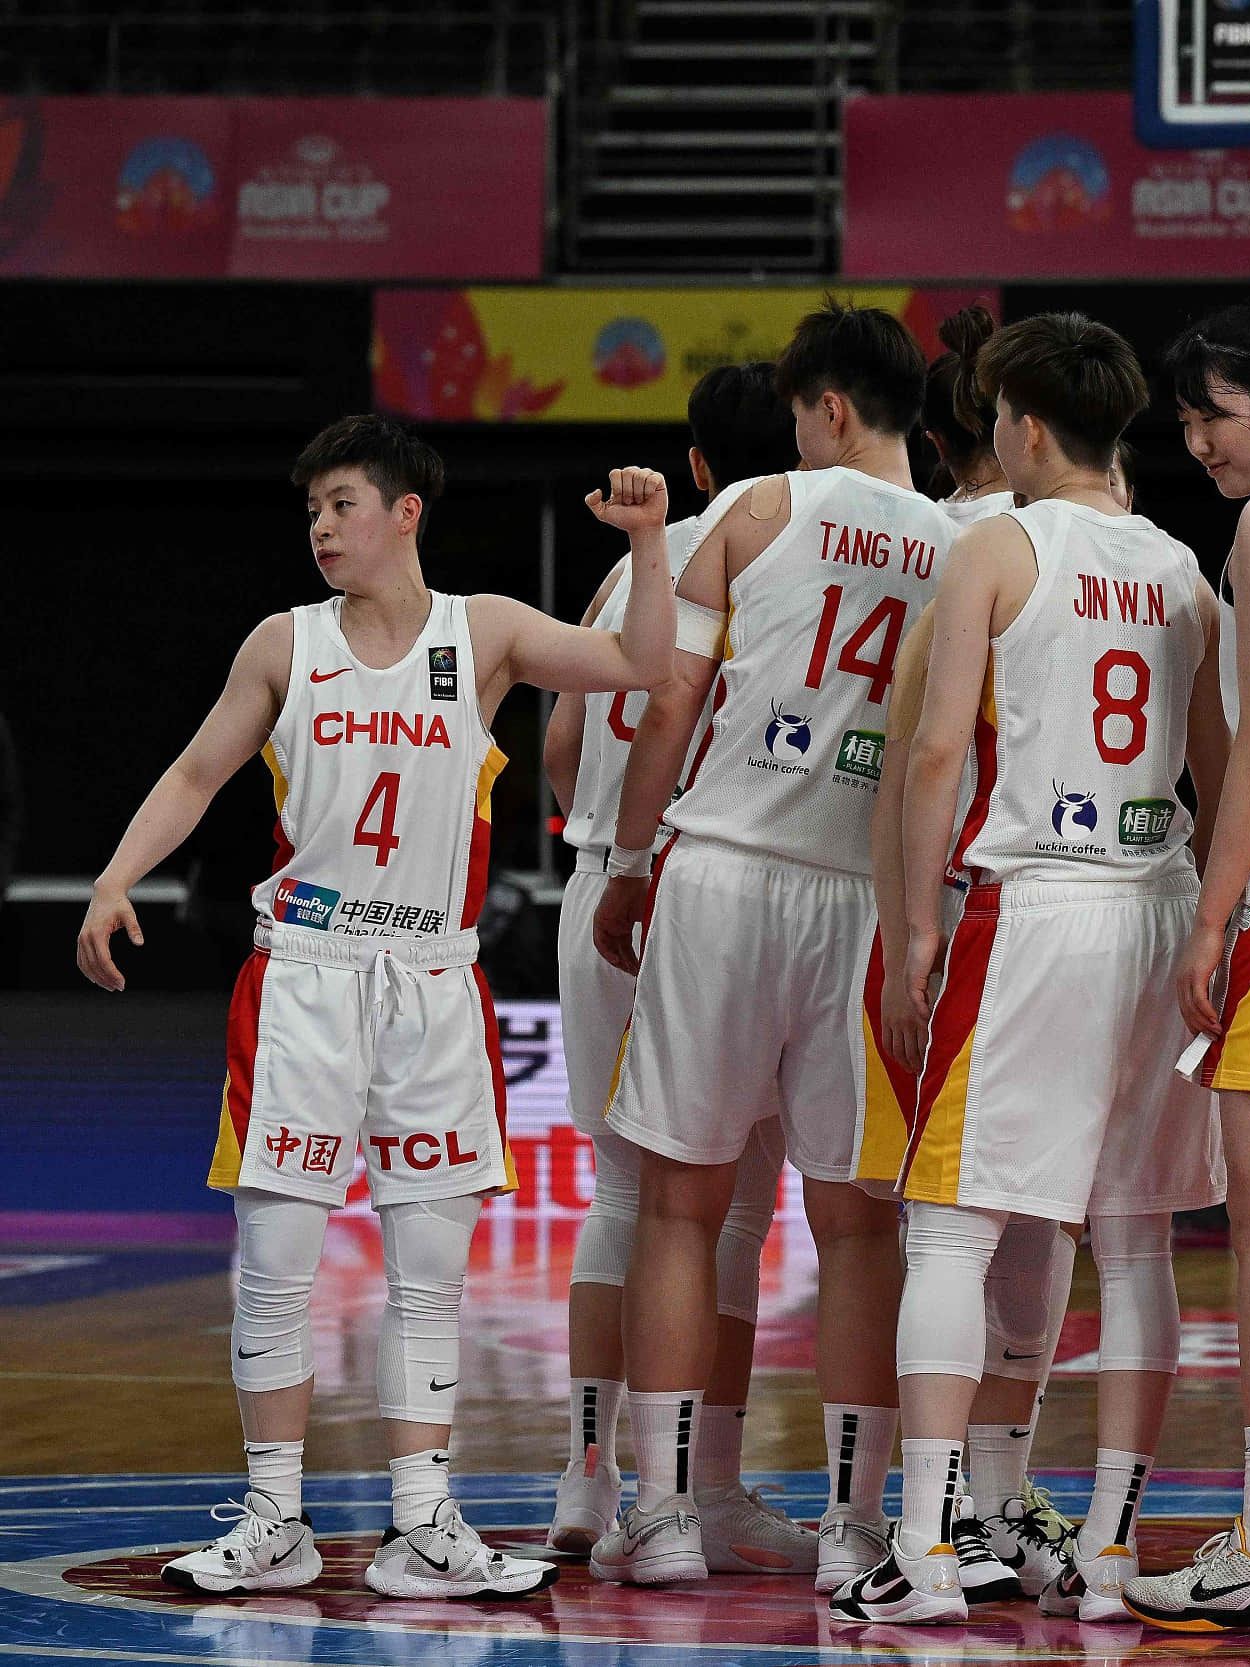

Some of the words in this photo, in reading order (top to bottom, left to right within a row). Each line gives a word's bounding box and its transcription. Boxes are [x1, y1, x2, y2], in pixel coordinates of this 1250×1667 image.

[820, 520, 893, 569] TANG
[902, 536, 936, 581] YU
[1073, 573, 1109, 622] JIN
[1112, 580, 1171, 628] W.N.
[805, 583, 909, 706] 14
[434, 676, 454, 688] FIBA
[1092, 648, 1152, 766] 8
[313, 710, 452, 749] CHINA
[747, 755, 779, 772] luckin
[781, 764, 811, 776] coffee
[352, 770, 402, 868] 4
[1122, 806, 1173, 834] 植选
[1035, 841, 1069, 853] luckin
[1071, 844, 1107, 856] coffee
[277, 888, 333, 917] UnionPay
[340, 899, 446, 935] 中国银联
[265, 1126, 342, 1174] 中国
[370, 1130, 478, 1171] TCL
